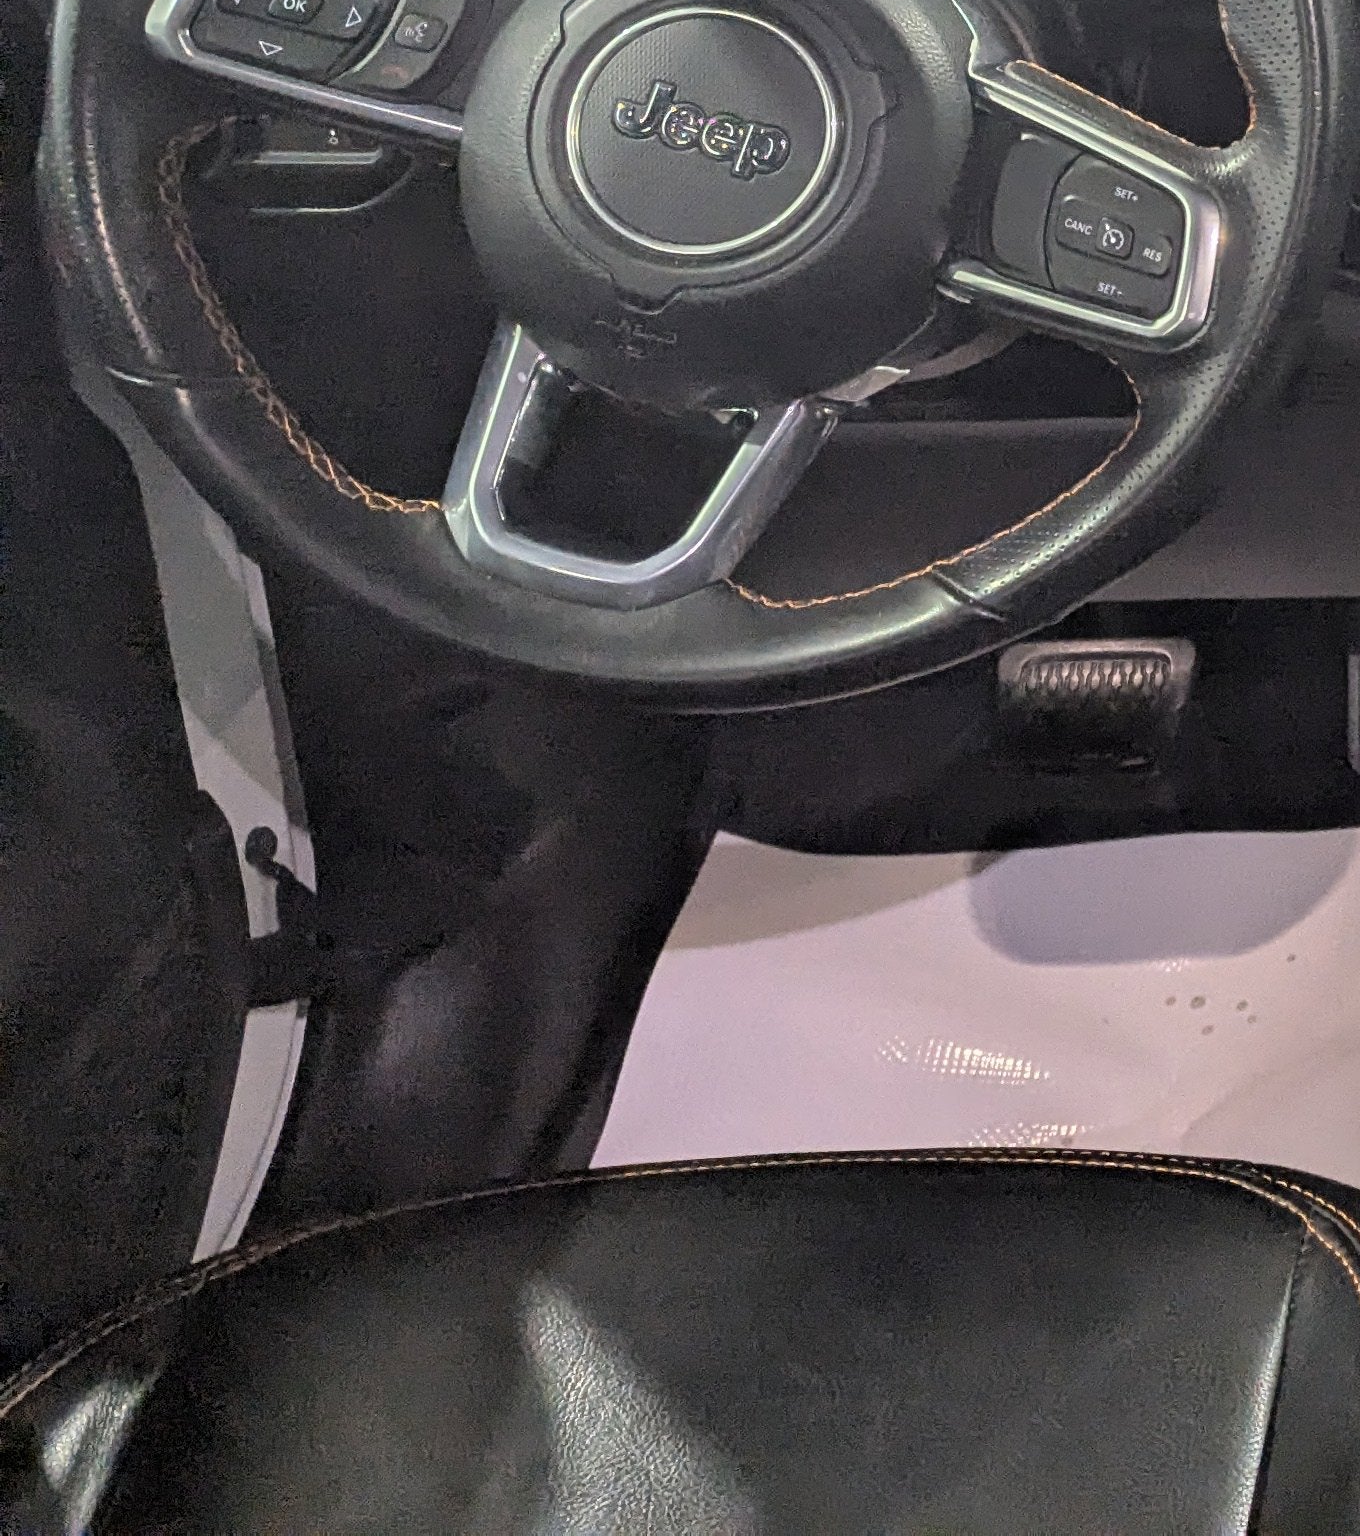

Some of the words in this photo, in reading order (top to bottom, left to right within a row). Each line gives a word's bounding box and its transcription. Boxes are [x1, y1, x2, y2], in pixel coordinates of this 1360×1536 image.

[612, 79, 793, 181] Jeep
[1114, 186, 1138, 202] SET+
[1064, 218, 1093, 236] CANC
[1142, 247, 1162, 263] RES
